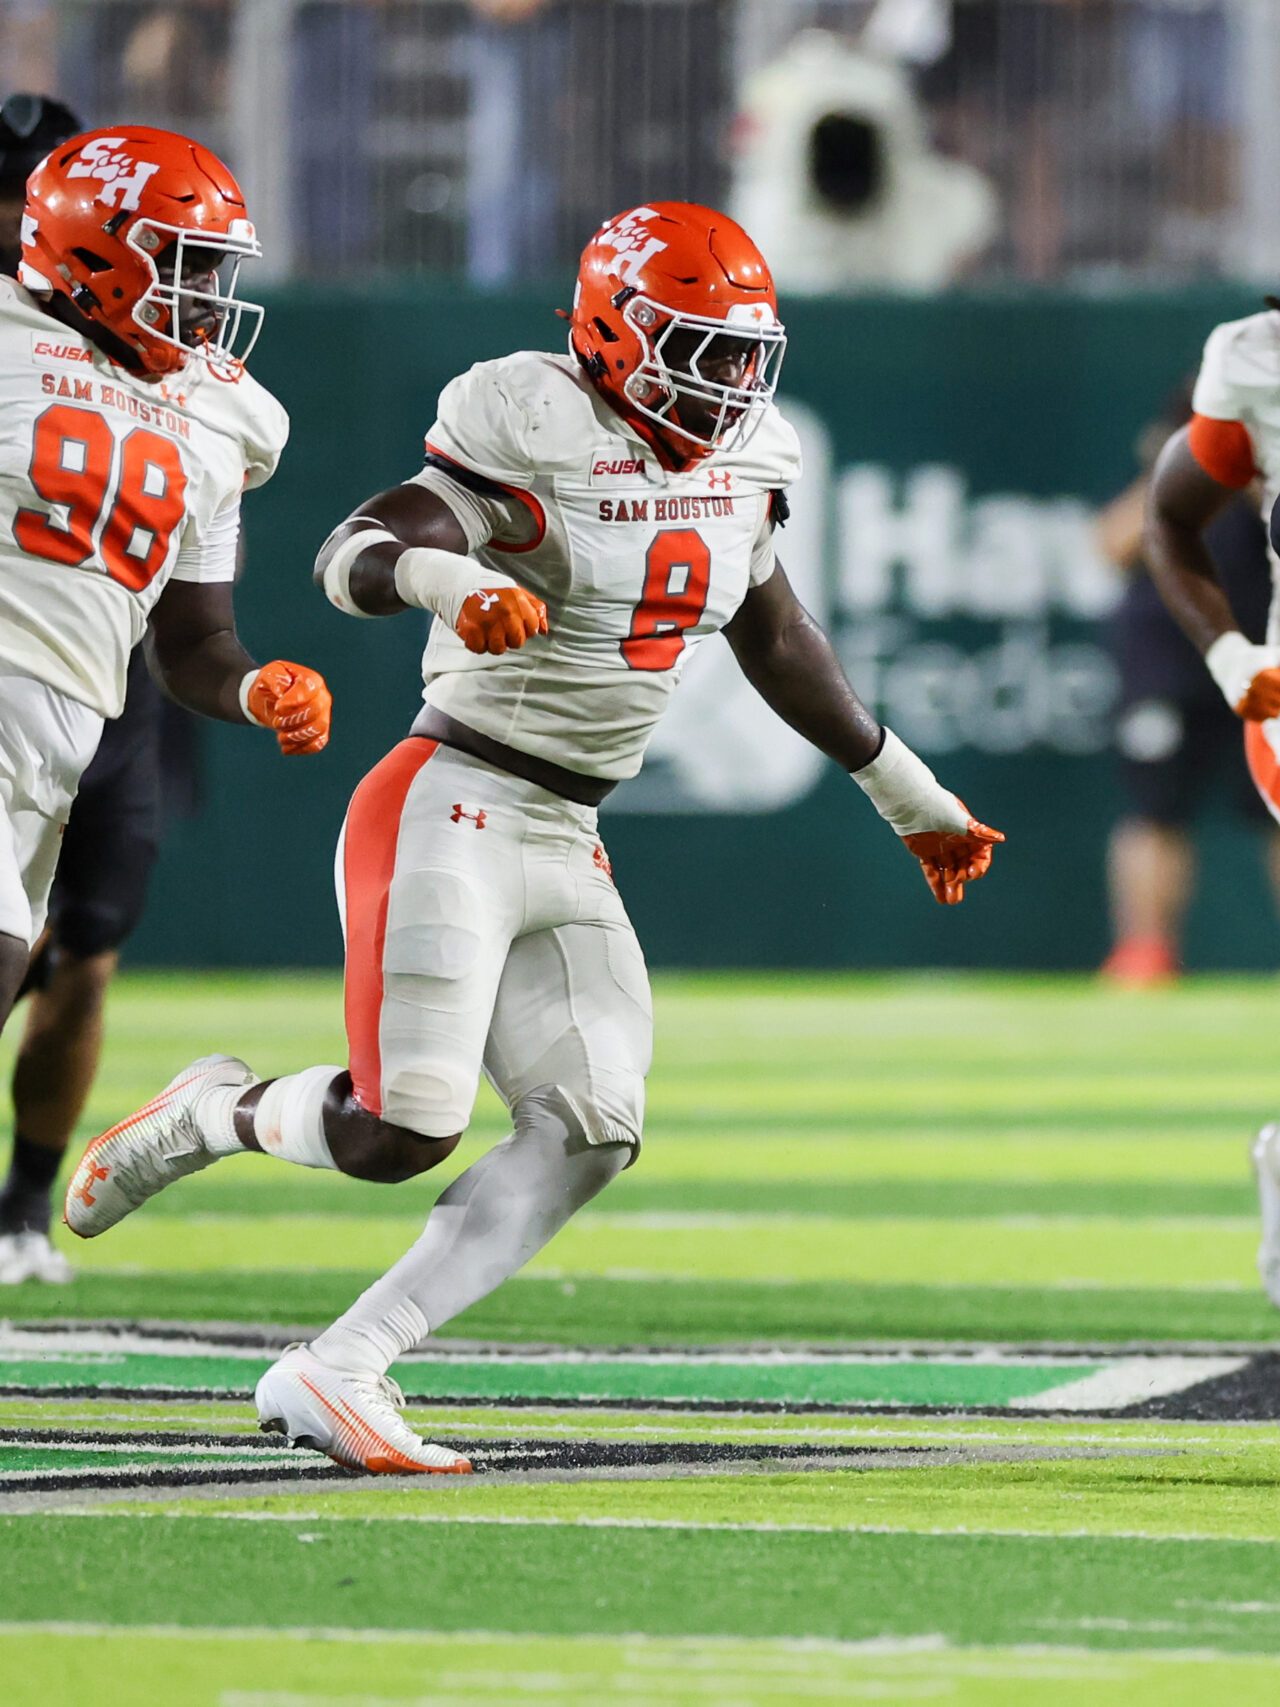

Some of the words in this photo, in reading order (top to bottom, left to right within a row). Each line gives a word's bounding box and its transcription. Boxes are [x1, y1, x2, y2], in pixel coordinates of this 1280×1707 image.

[41, 373, 93, 402] SAM
[101, 383, 190, 440] HOUSTON
[12, 402, 188, 593] 98
[599, 499, 648, 522] SAM
[654, 496, 735, 522] HOUSTON
[619, 528, 711, 671] 8
